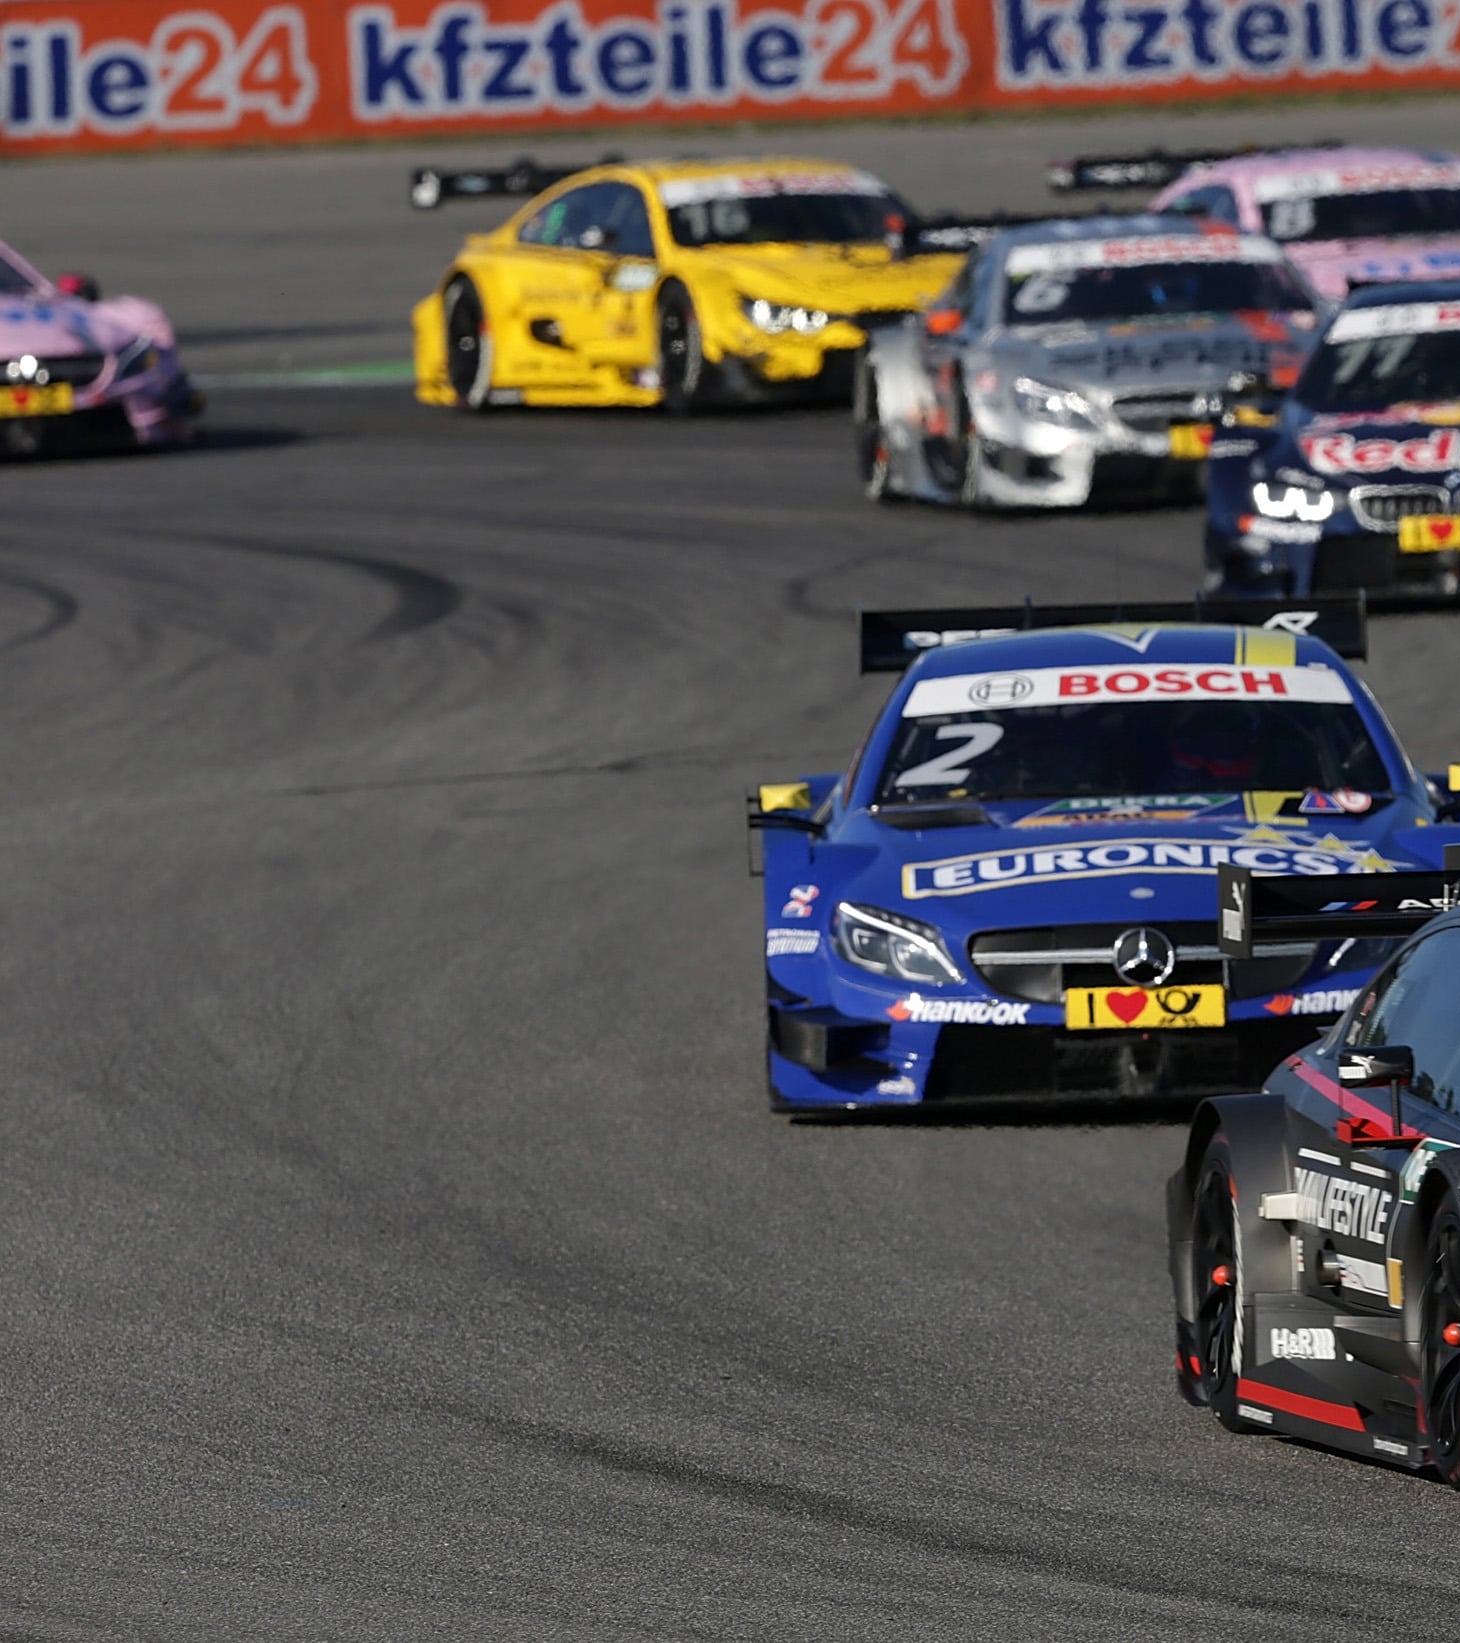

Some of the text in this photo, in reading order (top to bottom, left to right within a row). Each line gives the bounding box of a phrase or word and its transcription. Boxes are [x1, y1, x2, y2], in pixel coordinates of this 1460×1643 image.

[360, 0, 955, 104] kfzteile24
[1014, 268, 1072, 312] 6
[1058, 670, 1288, 696] BOSCH
[895, 722, 1005, 787] 2
[932, 844, 1339, 888] EURONICS
